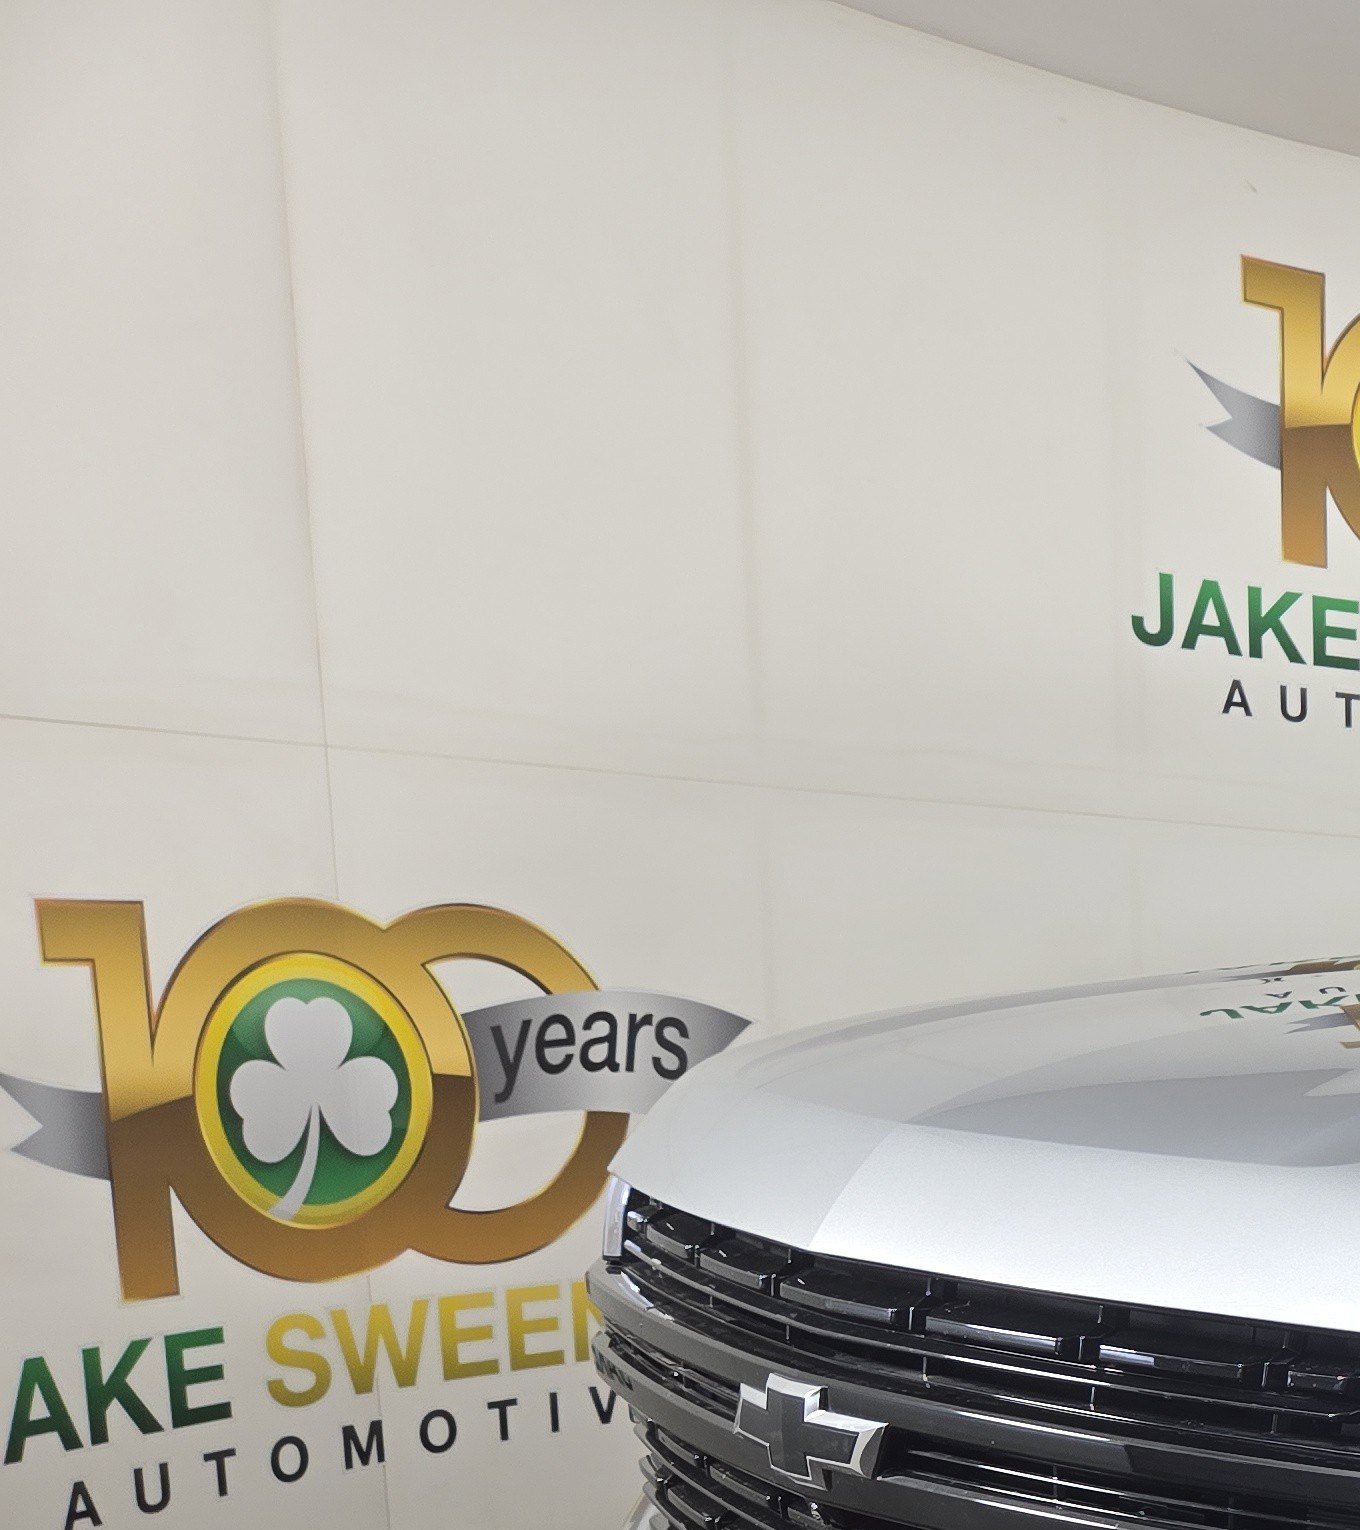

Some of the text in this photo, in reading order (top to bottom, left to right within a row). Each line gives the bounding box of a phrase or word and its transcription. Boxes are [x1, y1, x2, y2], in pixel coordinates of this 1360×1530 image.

[1131, 572, 1360, 671] JAKE
[34, 897, 690, 1301] 100 years
[4, 1281, 605, 1465] AKE SWEEN
